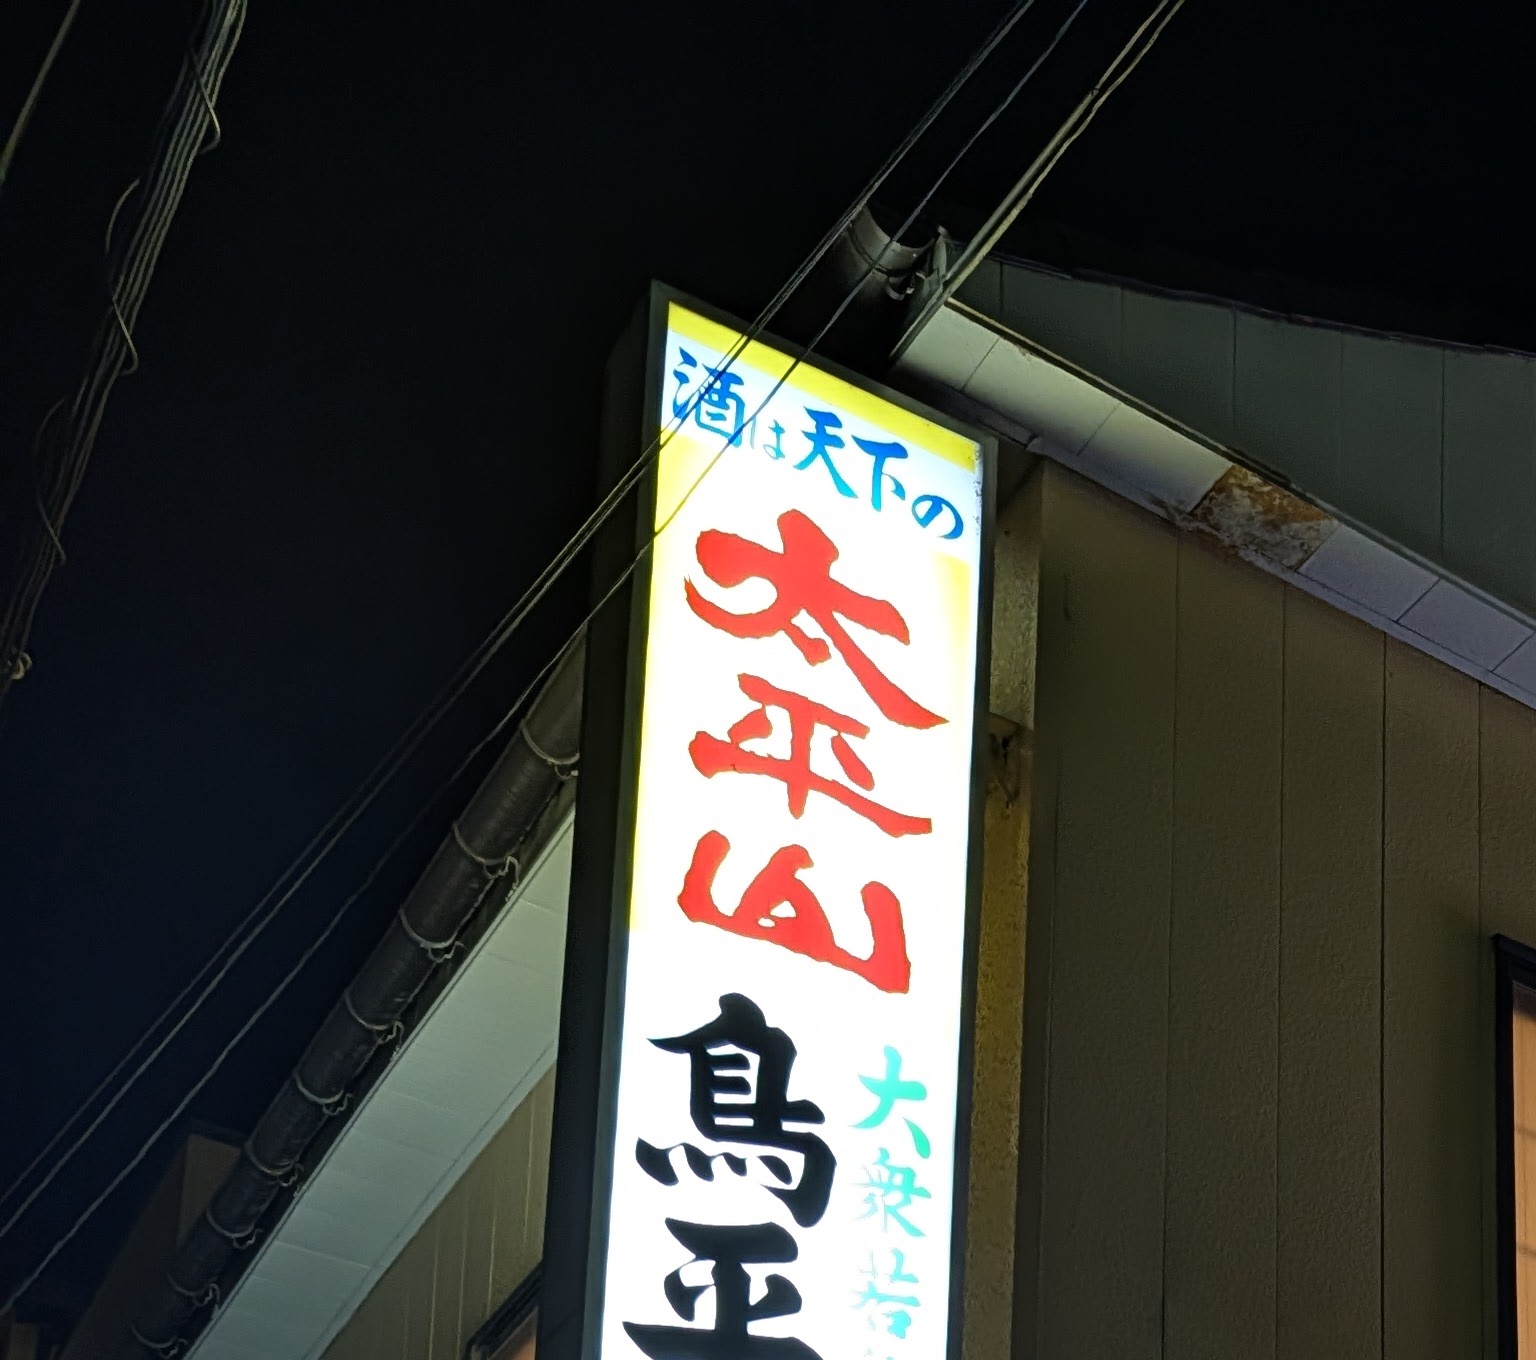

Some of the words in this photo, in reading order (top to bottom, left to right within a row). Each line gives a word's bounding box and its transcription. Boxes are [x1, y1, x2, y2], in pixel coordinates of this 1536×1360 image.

[672, 347, 965, 541] 酒は天下の
[677, 508, 949, 994] 太平山
